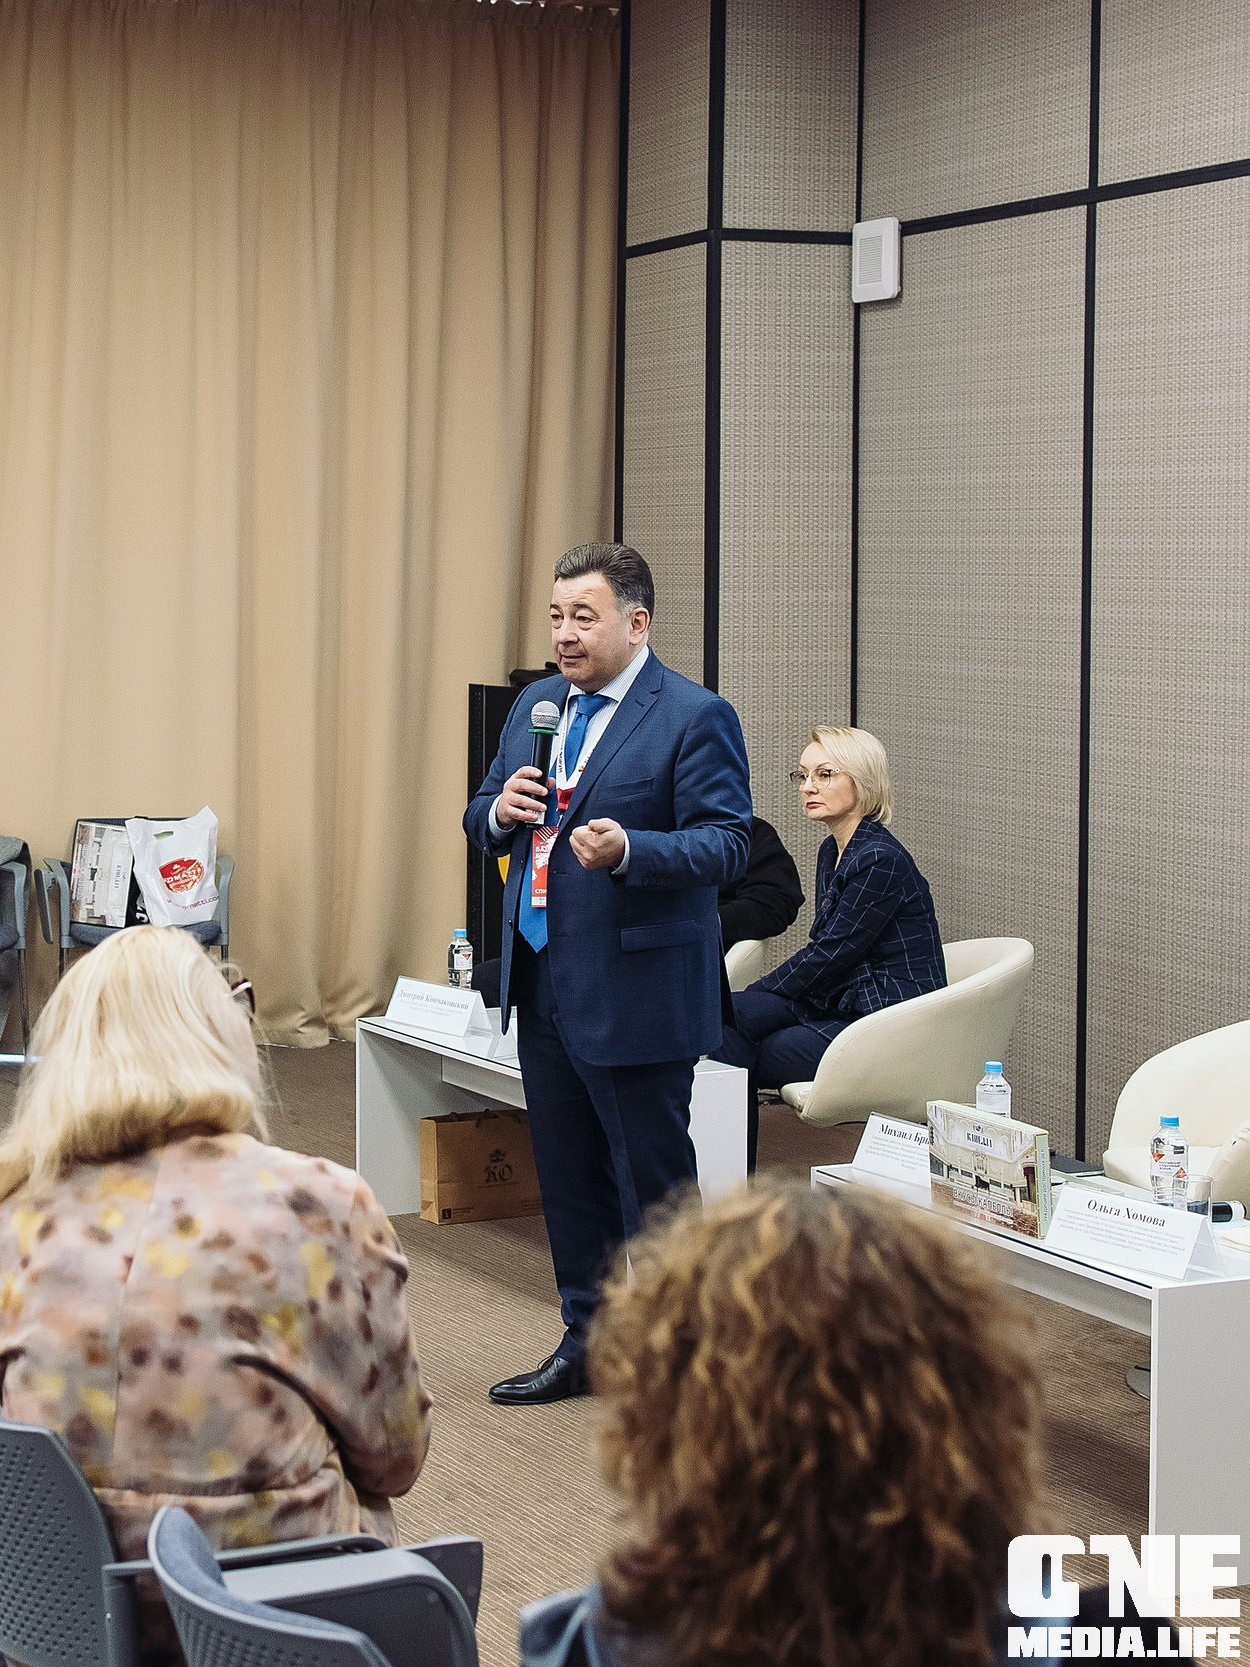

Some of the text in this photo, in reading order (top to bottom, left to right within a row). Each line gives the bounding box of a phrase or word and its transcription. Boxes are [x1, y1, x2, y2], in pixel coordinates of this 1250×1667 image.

[879, 1123, 912, 1141] Михаил
[1087, 1199, 1166, 1228] Ольга Хомова
